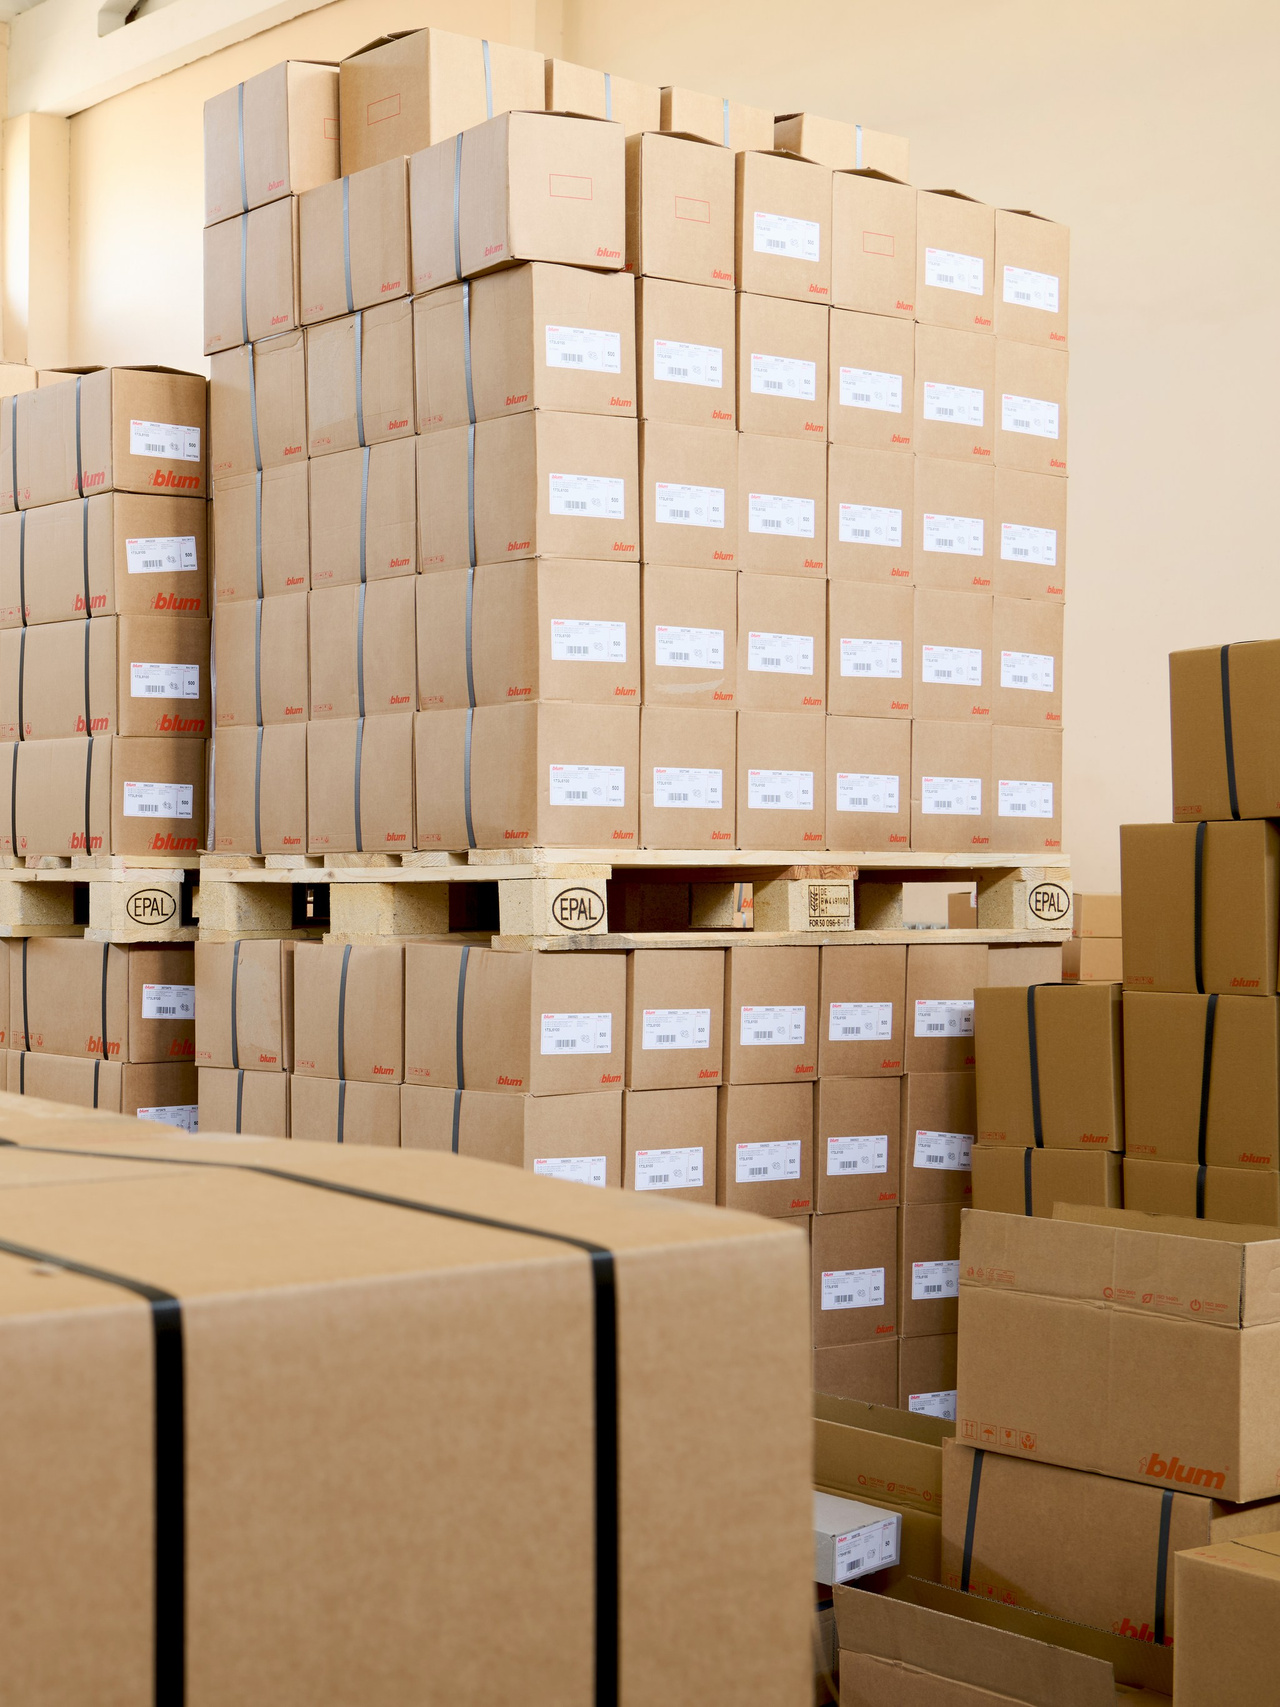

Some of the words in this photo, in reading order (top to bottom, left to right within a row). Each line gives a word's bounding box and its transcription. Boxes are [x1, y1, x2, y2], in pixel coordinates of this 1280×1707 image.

[484, 243, 504, 256] blum
[596, 248, 621, 259] blum
[713, 269, 733, 281] blum
[381, 281, 400, 292] blum
[809, 283, 828, 294] blum
[896, 301, 913, 311] blum
[271, 315, 289, 325] blum
[974, 316, 991, 326] blum
[1050, 333, 1066, 342] blum
[504, 395, 528, 405] blum
[610, 397, 632, 407] blum
[712, 410, 732, 421] blum
[388, 420, 408, 430] blum
[804, 422, 824, 432] blum
[891, 434, 910, 443] blum
[284, 446, 302, 455] blum
[972, 446, 990, 456] blum
[1050, 460, 1066, 468] blum
[153, 469, 201, 489] blum
[508, 541, 530, 552] blum
[612, 542, 635, 551] blum
[713, 551, 733, 560] blum
[389, 558, 410, 568] blum
[804, 560, 823, 568] blum
[891, 568, 909, 577] blum
[972, 577, 990, 585] blum
[1047, 586, 1063, 594] blum
[154, 592, 202, 611] blum
[507, 687, 532, 696] blum
[615, 687, 636, 697] blum
[713, 691, 733, 700] blum
[390, 696, 410, 704] blum
[803, 697, 822, 705] blum
[890, 701, 909, 710] blum
[972, 706, 989, 714] blum
[284, 707, 303, 715] blum
[1046, 712, 1060, 720] blum
[77, 715, 109, 732] bum
[159, 714, 206, 732] blum
[385, 833, 406, 841] blum
[504, 830, 529, 839] blum
[612, 830, 634, 840] blum
[711, 831, 731, 840] blum
[803, 832, 822, 841] blum
[889, 834, 907, 844] blum
[152, 833, 198, 851] blum
[283, 837, 301, 845] blum
[971, 836, 989, 844] blum
[1044, 839, 1060, 847] blum
[133, 898, 168, 917] EPAL
[742, 898, 754, 908] bl
[1034, 893, 1063, 913] EPAL
[559, 897, 597, 921] EPAL
[1231, 978, 1259, 987] blum
[170, 1038, 195, 1057] blu
[259, 1054, 277, 1063] blum
[881, 1060, 900, 1068] blum
[373, 1066, 394, 1075] blum
[794, 1064, 814, 1074] blum
[600, 1074, 621, 1083] blum
[698, 1070, 719, 1078] blum
[497, 1076, 523, 1086] blum
[1081, 1134, 1108, 1144] blum
[1243, 1154, 1279, 1165] blum
[879, 1192, 897, 1200] blum
[791, 1199, 810, 1208] blum
[876, 1325, 894, 1334] blum
[1145, 1453, 1226, 1489] blum
